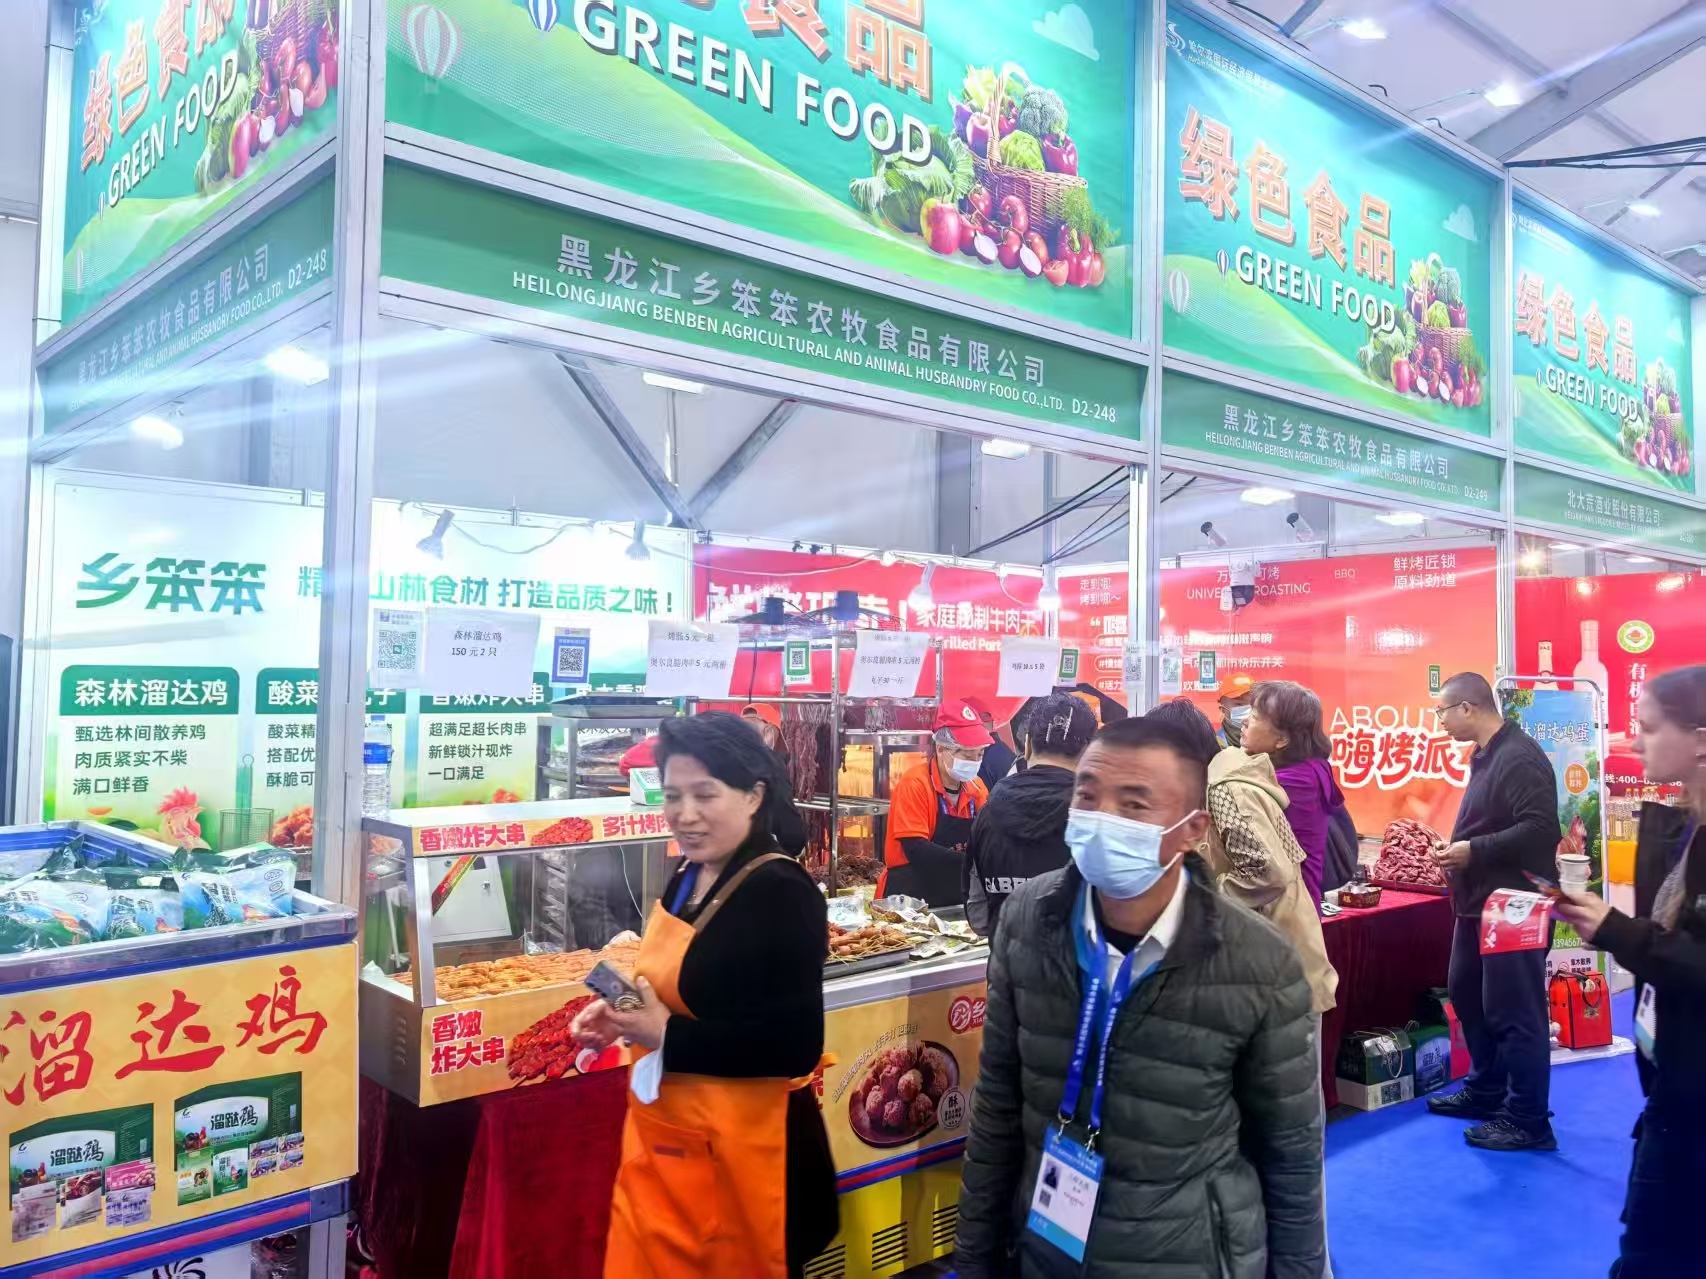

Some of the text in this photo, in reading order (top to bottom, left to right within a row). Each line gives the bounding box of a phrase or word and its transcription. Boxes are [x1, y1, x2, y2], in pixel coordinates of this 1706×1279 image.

[573, 0, 932, 166] GREEN FOOD
[107, 50, 240, 207] GREEN FOOD
[1178, 104, 1397, 288] 绿色食品
[287, 247, 328, 290] D2-248
[1234, 245, 1398, 333] GREEN FOOD
[556, 233, 1045, 387] 黑龙江乡笨笨农牧食品有限公司
[1515, 273, 1638, 388] 绿色食品
[512, 271, 648, 318] HEILONGJIANG
[652, 303, 718, 334] BENBEN
[721, 320, 833, 366] AGRICULTURAL
[834, 348, 863, 367] AND
[864, 353, 913, 378] ANIMAL
[915, 364, 988, 396] HUSBANDRY
[989, 381, 1020, 402] FOOD
[1071, 396, 1117, 424] D2-248
[1546, 366, 1638, 423] GREEN FOOD
[1205, 431, 1264, 454] HEILONGJIANG
[1223, 403, 1449, 480] 黑龙江乡笨笨农牧食品有限公司
[1334, 568, 1356, 580] BBQ
[1393, 553, 1456, 571] 鲜烤匠锁
[76, 552, 267, 615] 乡笨笨
[1253, 582, 1311, 598] ROASTING
[1393, 573, 1457, 591] 原料劲道
[453, 630, 502, 643] 森林溜达鸡
[74, 679, 228, 706] 森林溜达鸡
[75, 724, 206, 743] 甄选林间散养鸡
[428, 721, 528, 737] 超满足超长肉串
[74, 749, 188, 769] 肉质紧实不柴
[428, 743, 513, 759] 新鲜锁汁现炸
[1331, 728, 1467, 786] 嗨烤派
[73, 775, 149, 795] 满口鲜香
[428, 766, 485, 781] 一口满足
[419, 823, 526, 852] 香嫩炸大串
[431, 1009, 484, 1044] 香嫩
[430, 1036, 505, 1076] 炸大串
